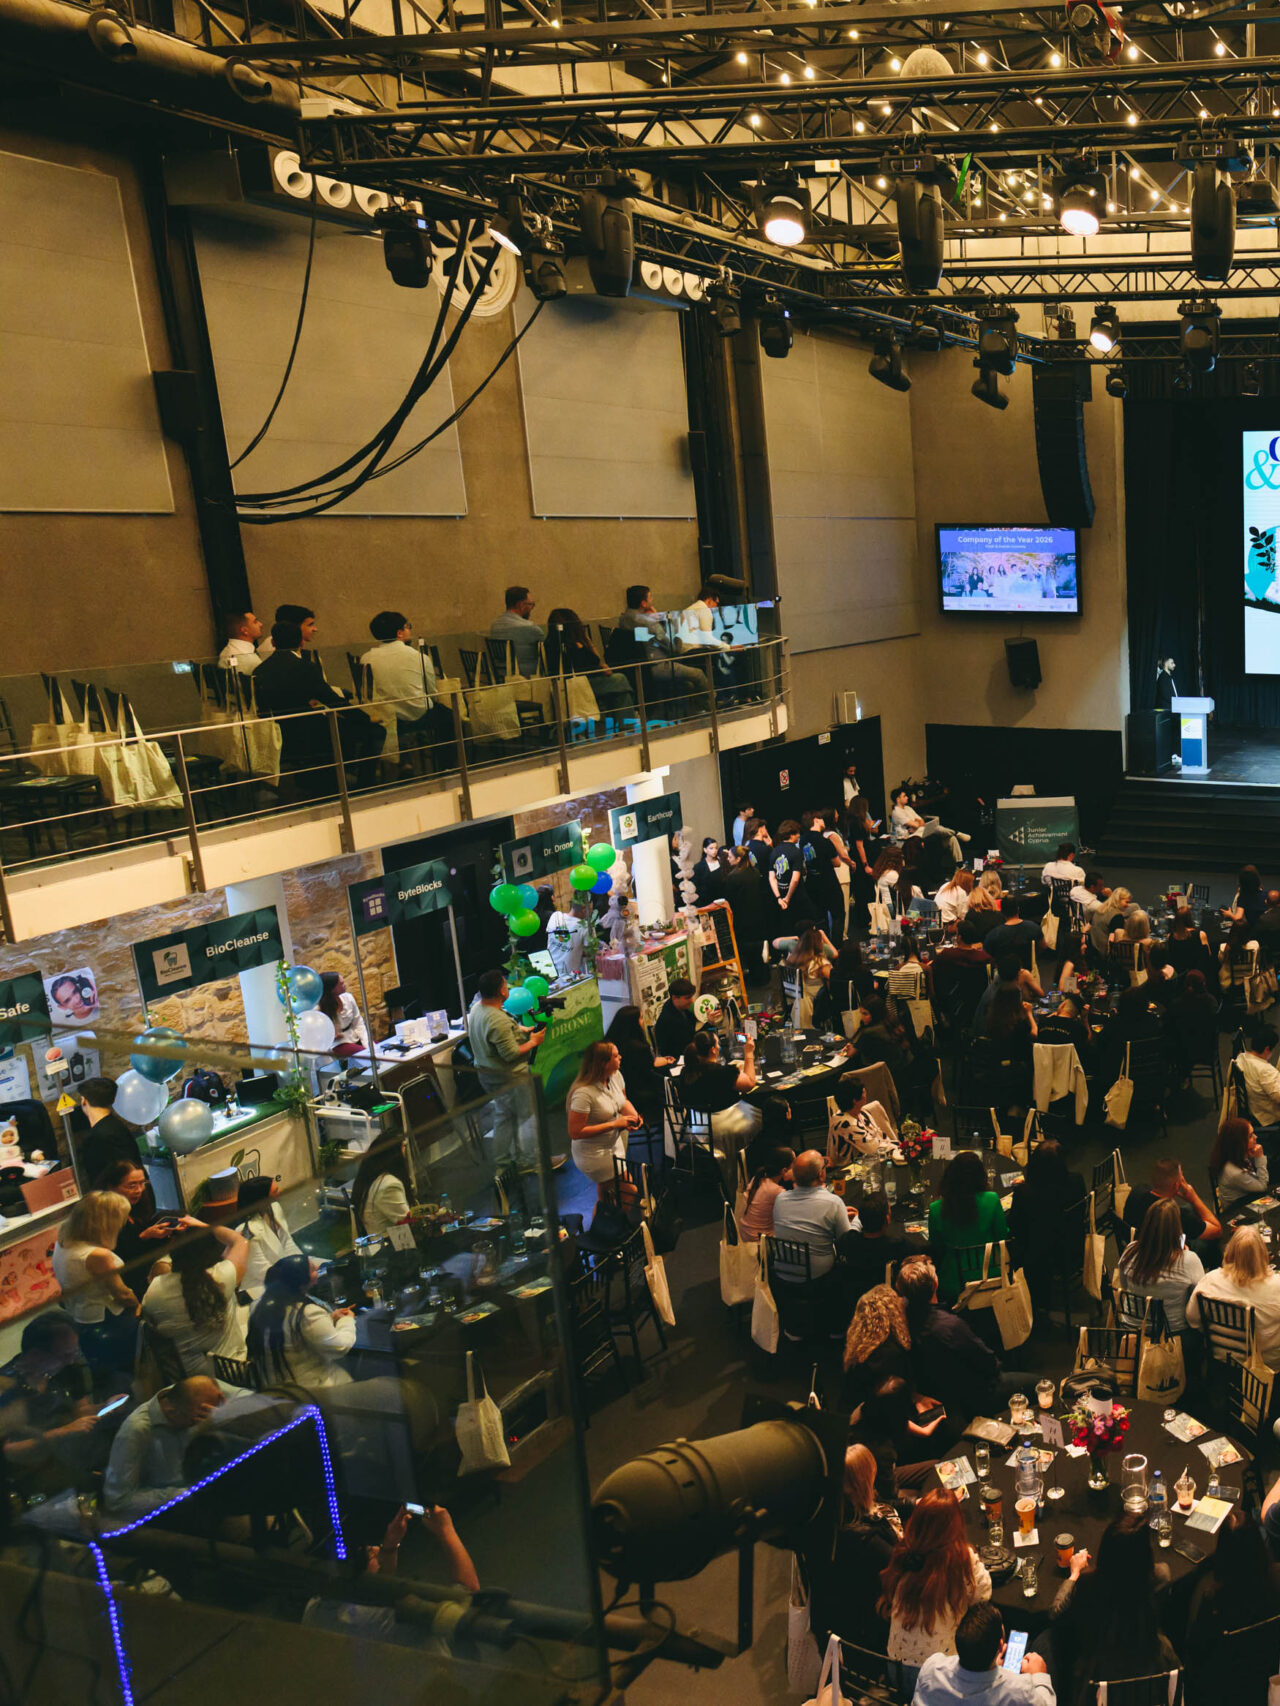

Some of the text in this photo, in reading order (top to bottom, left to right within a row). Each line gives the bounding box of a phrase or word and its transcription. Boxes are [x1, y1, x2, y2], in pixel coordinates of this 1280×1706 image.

[957, 536, 993, 544] Company
[647, 810, 673, 823] Earthcup
[543, 841, 574, 857] Dr. Drone
[397, 880, 442, 903] ByteBlocks
[206, 931, 269, 957] BioCleanse
[551, 1012, 592, 1039] DRONE
